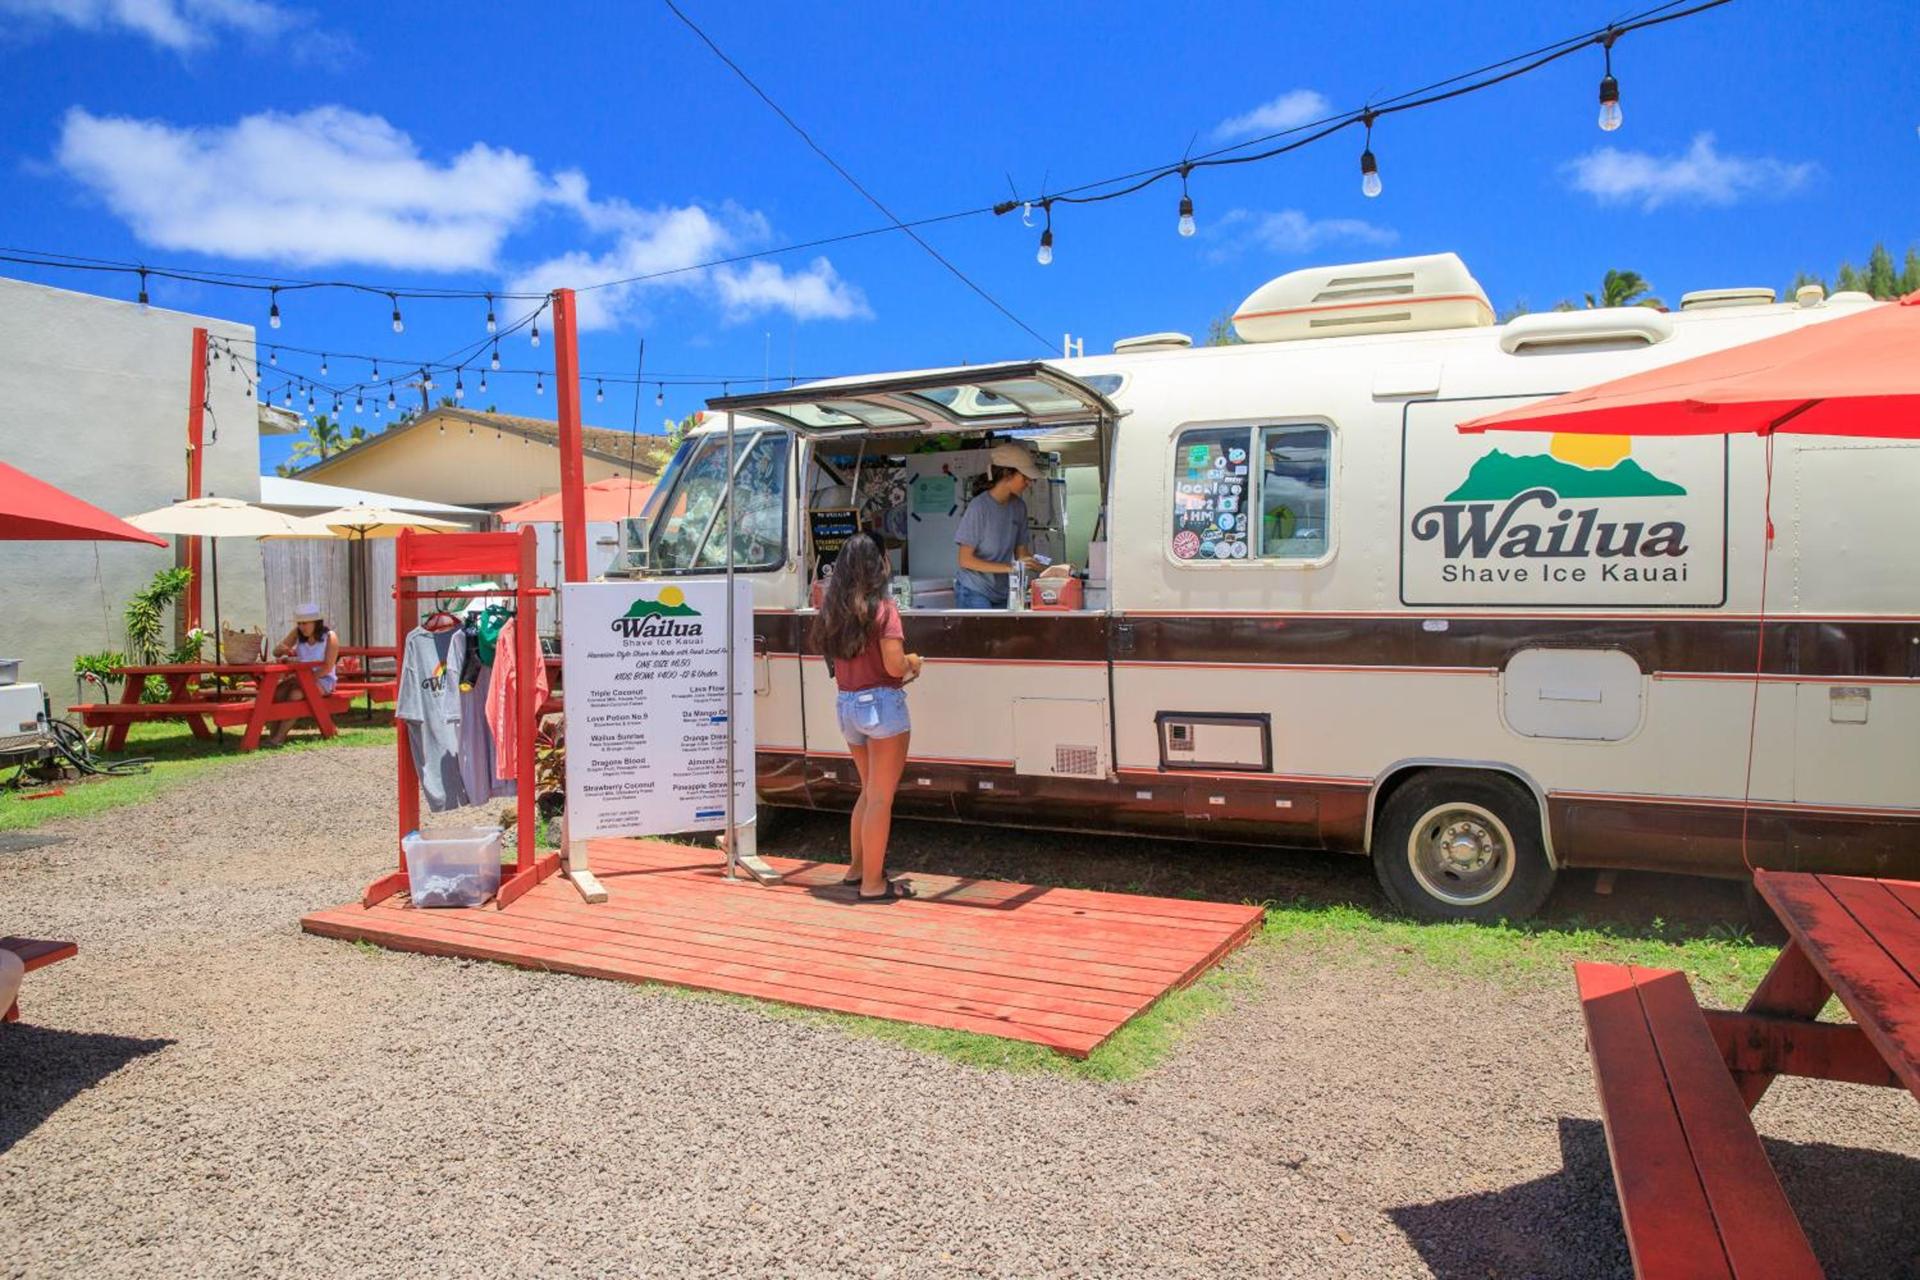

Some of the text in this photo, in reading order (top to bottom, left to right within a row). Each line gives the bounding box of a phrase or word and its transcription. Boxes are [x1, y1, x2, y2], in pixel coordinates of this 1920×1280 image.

[1411, 489, 1689, 559] Wailua
[1442, 563, 1688, 582] Shave Ice Kauai
[611, 612, 703, 638] Wailua
[635, 660, 653, 669] ONE
[653, 659, 670, 668] SIZE
[606, 714, 631, 722] Potion
[617, 733, 645, 741] Sunrise
[583, 784, 623, 792] Strawberry
